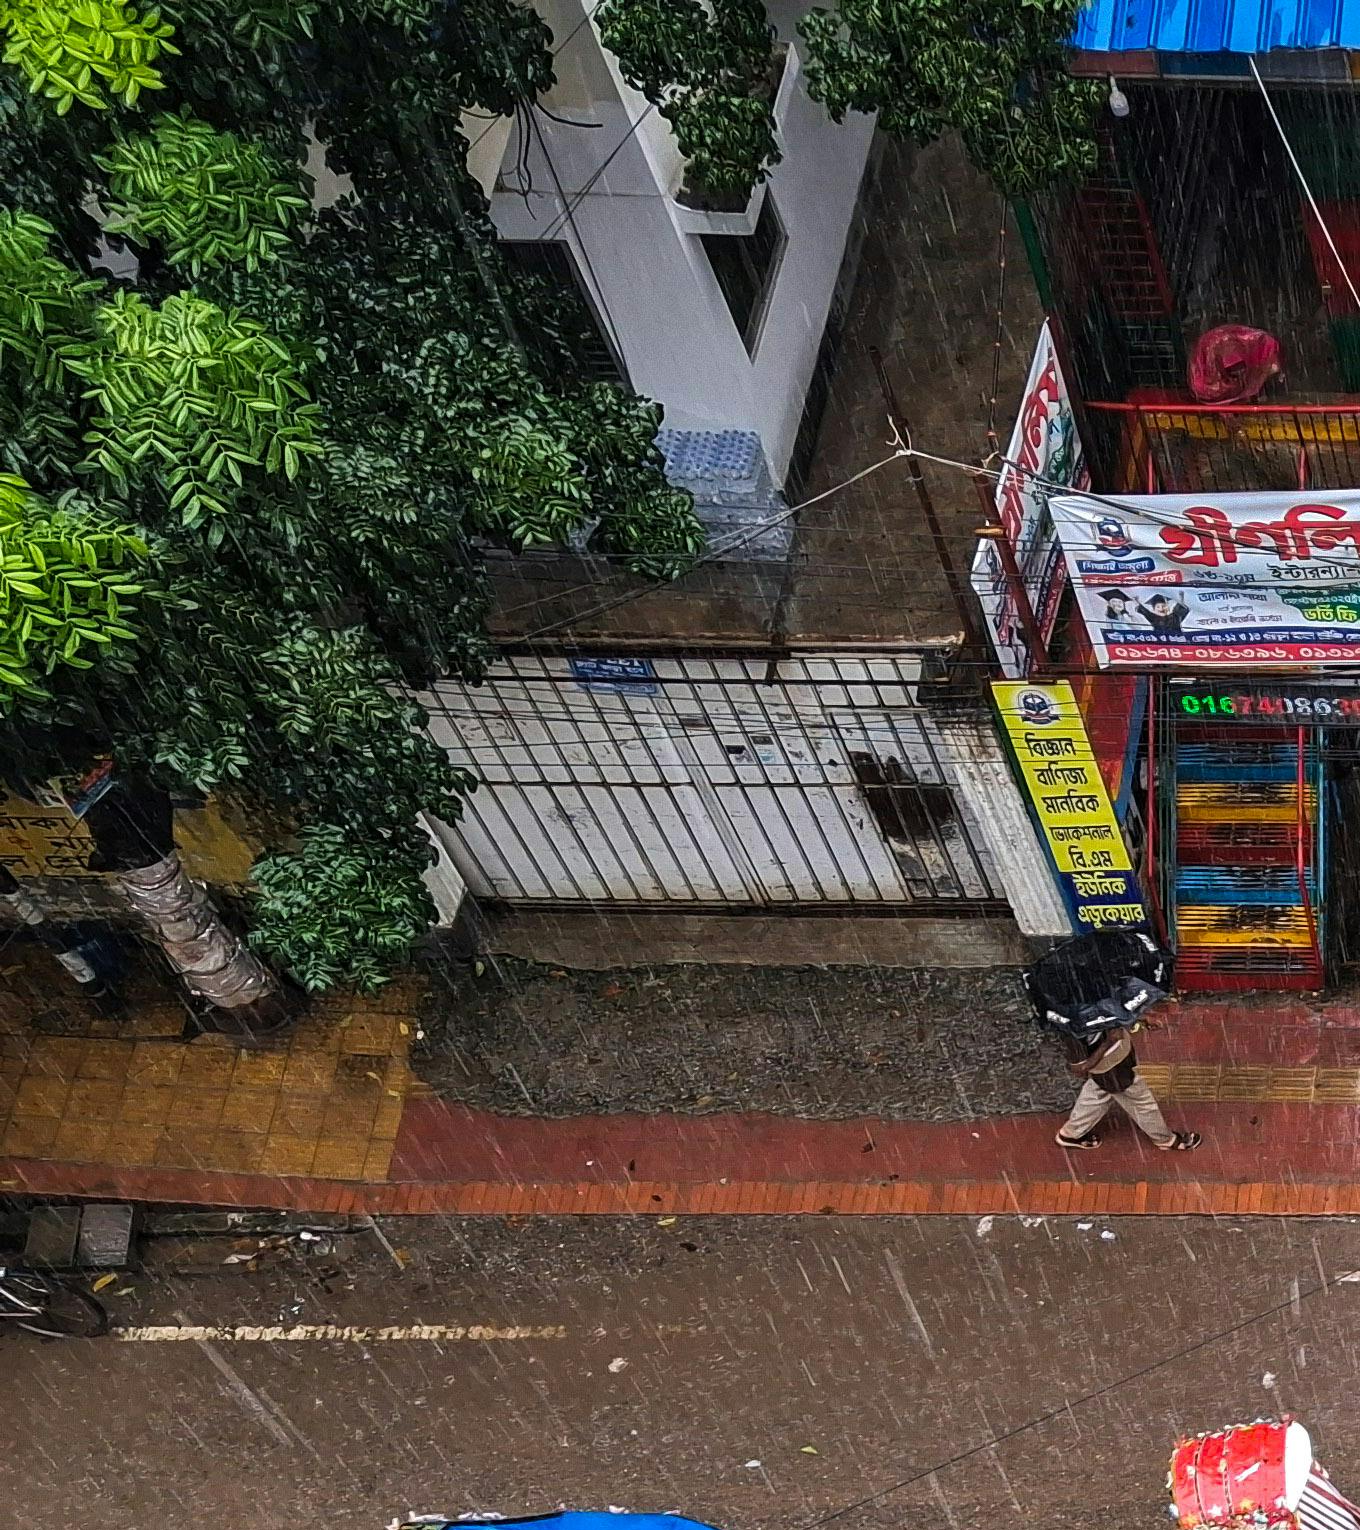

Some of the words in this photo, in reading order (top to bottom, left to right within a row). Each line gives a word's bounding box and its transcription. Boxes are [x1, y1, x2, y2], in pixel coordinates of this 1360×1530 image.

[1303, 604, 1334, 621] ভর্তি
[1337, 605, 1357, 621] ফি
[1115, 646, 1294, 660] ০১৬৭৪-০৮৬৩৯৬,
[1025, 733, 1076, 757] বিজ্ঞান
[1034, 761, 1088, 786] বাণিজ্য
[1041, 789, 1100, 814] মানবিক
[1049, 825, 1115, 842] ভোকেশনাল
[1068, 846, 1114, 870] বি.এম
[1073, 871, 1127, 898] ইউনিক
[1078, 904, 1145, 928] এডুকেয়ার
